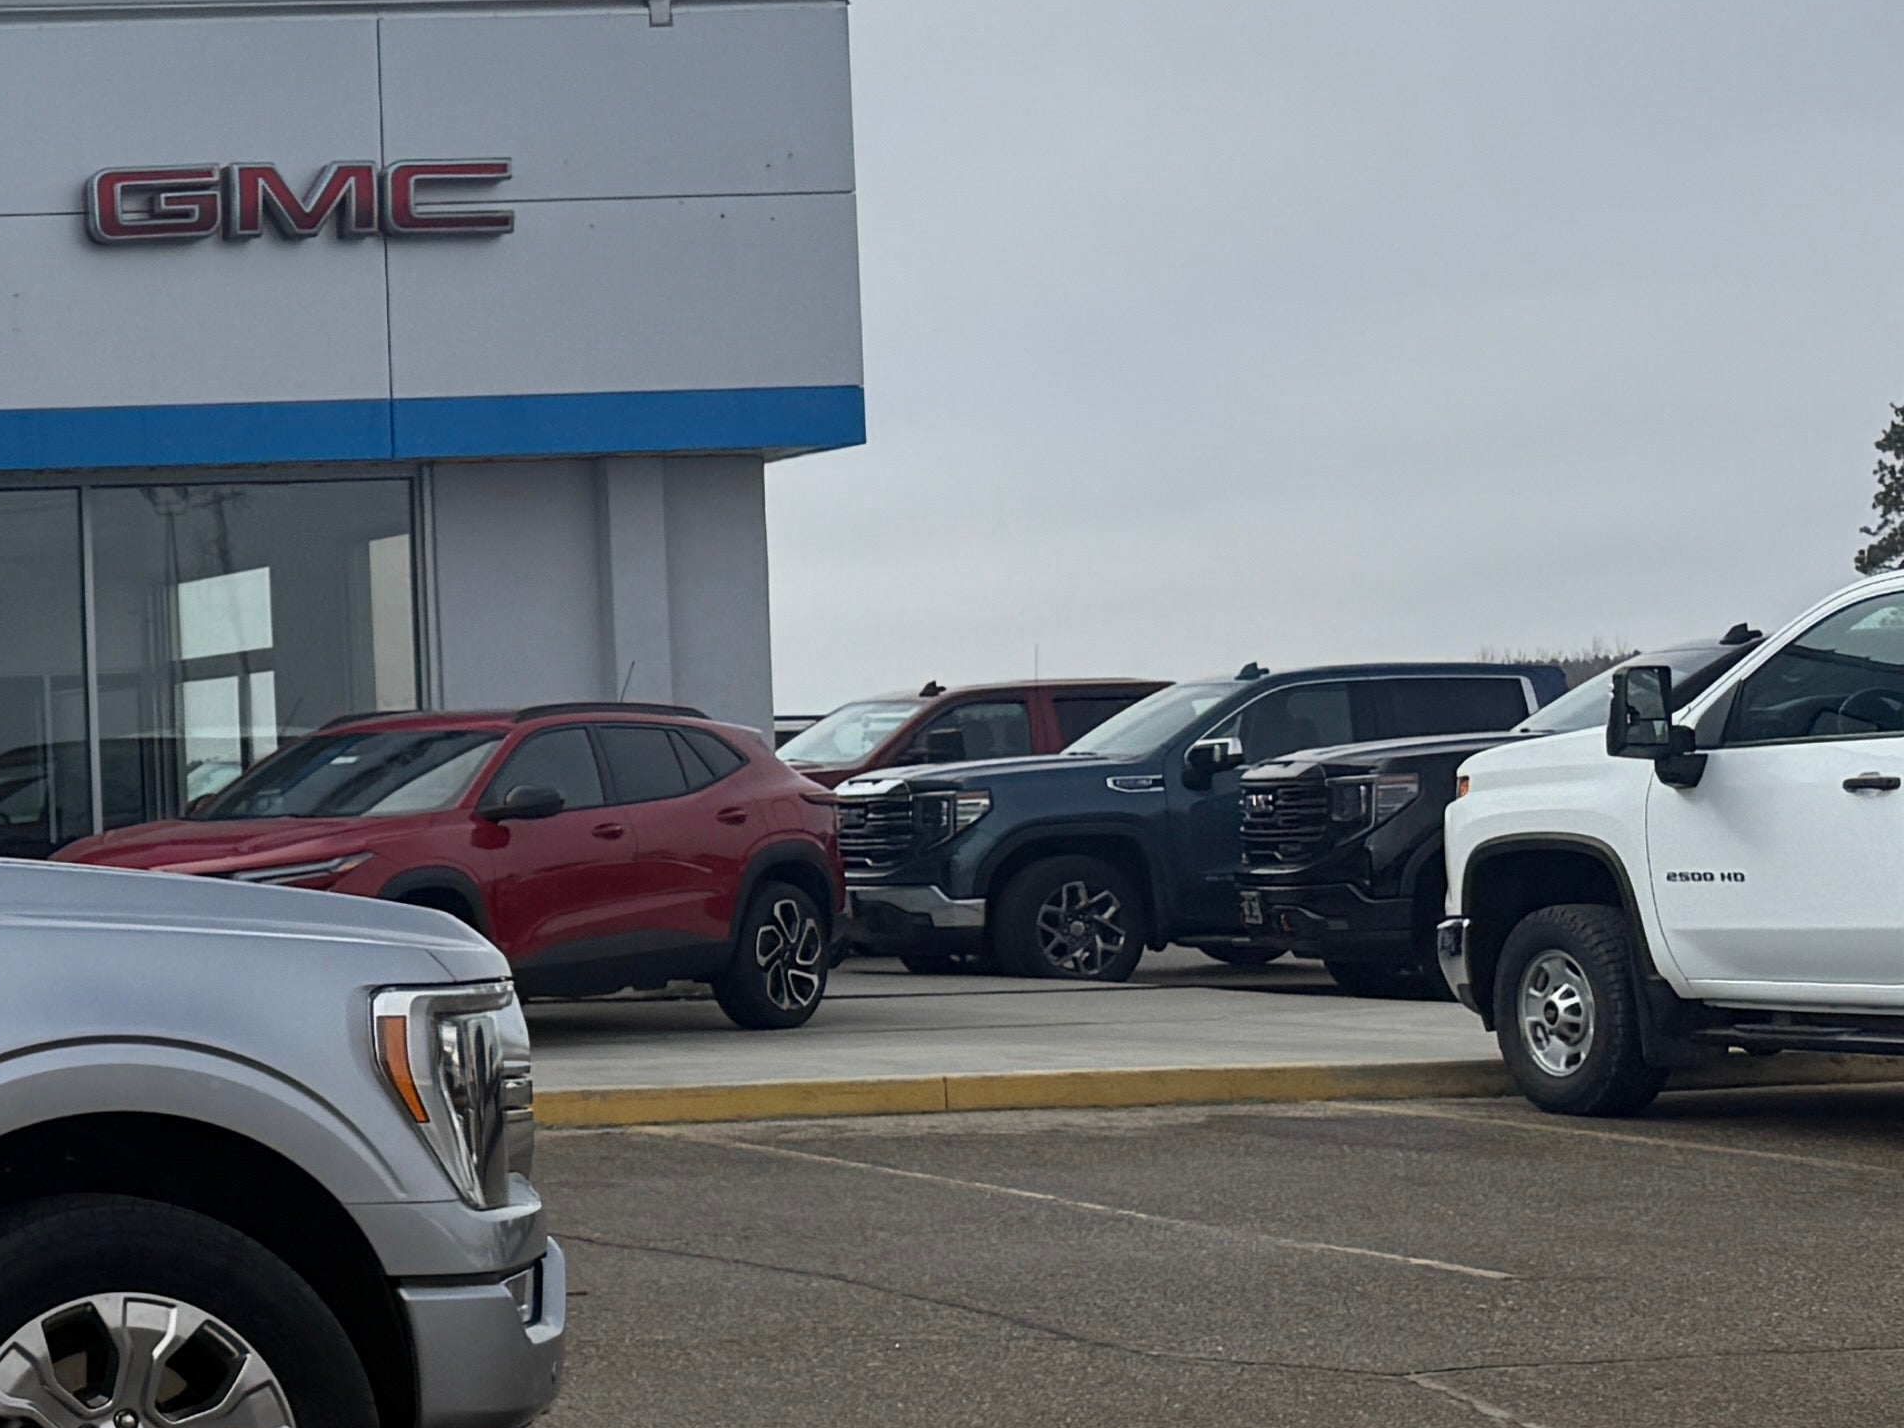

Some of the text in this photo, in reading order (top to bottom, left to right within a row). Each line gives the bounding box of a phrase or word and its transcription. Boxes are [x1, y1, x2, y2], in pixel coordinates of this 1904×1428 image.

[86, 156, 516, 245] GMC
[1666, 871, 1746, 883] 2500 HD
